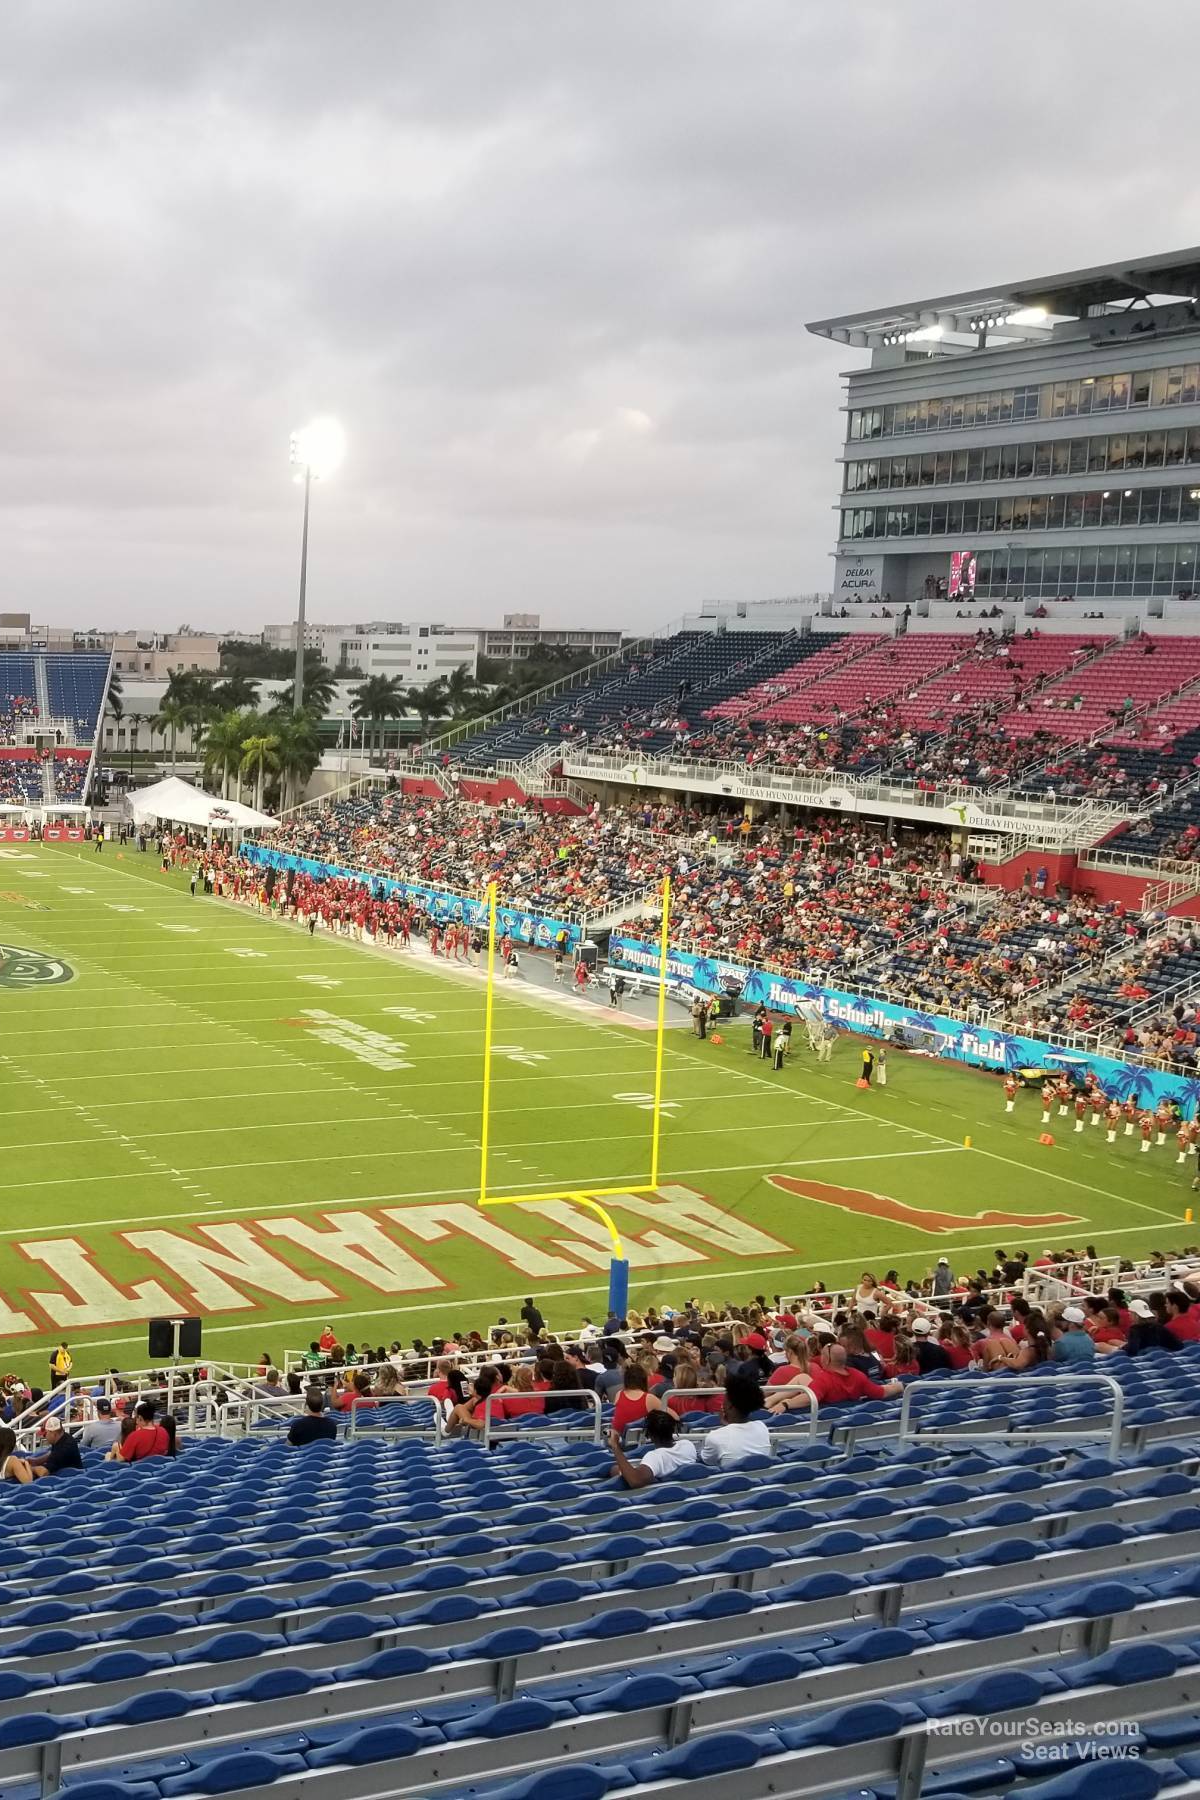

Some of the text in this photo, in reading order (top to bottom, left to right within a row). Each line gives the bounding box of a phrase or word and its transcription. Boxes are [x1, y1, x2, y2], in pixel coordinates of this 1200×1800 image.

[846, 568, 874, 577] DELRAY
[841, 579, 876, 588] ACURA
[736, 786, 825, 805] DELRAY HYUNDAI DECK
[969, 816, 1002, 828] DELRAY
[1003, 820, 1045, 834] HYUNDAI
[962, 1032, 1006, 1062] Field
